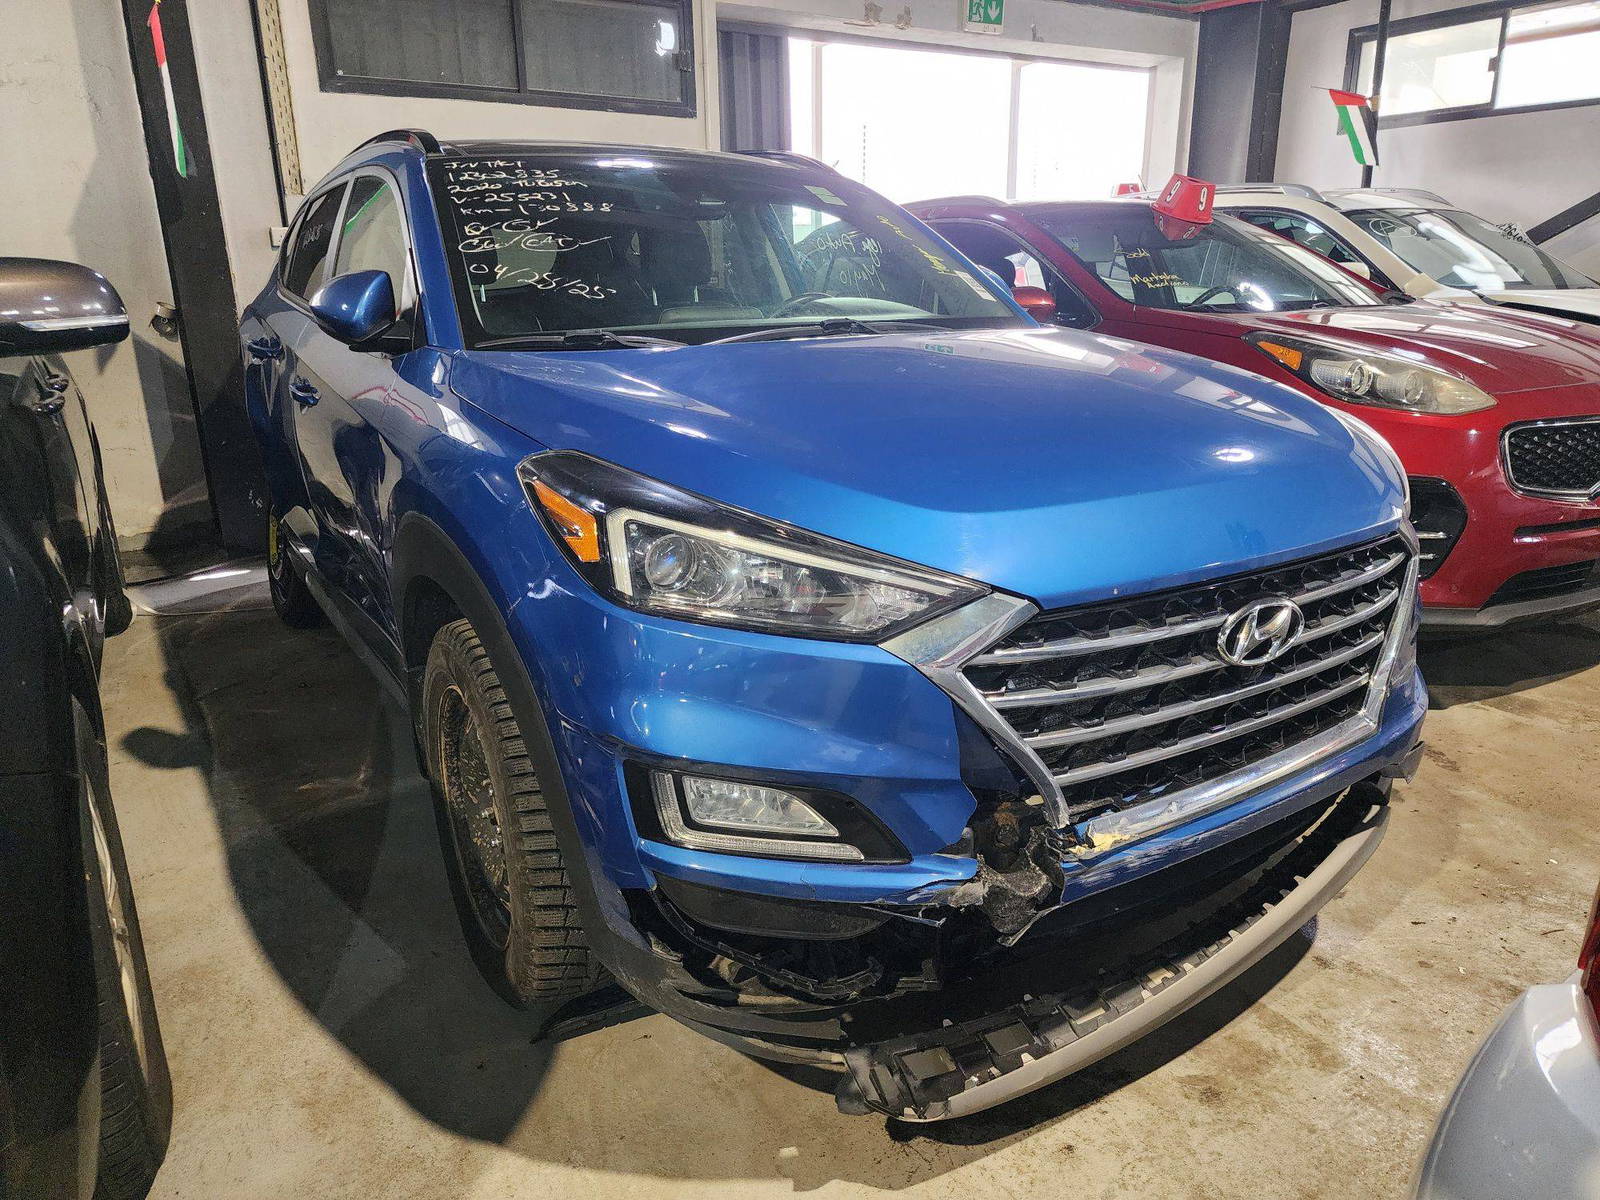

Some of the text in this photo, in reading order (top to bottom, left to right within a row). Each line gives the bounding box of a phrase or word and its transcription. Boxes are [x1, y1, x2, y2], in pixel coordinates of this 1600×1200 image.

[447, 182, 502, 194] 2020
[1165, 179, 1208, 211] 9 9
